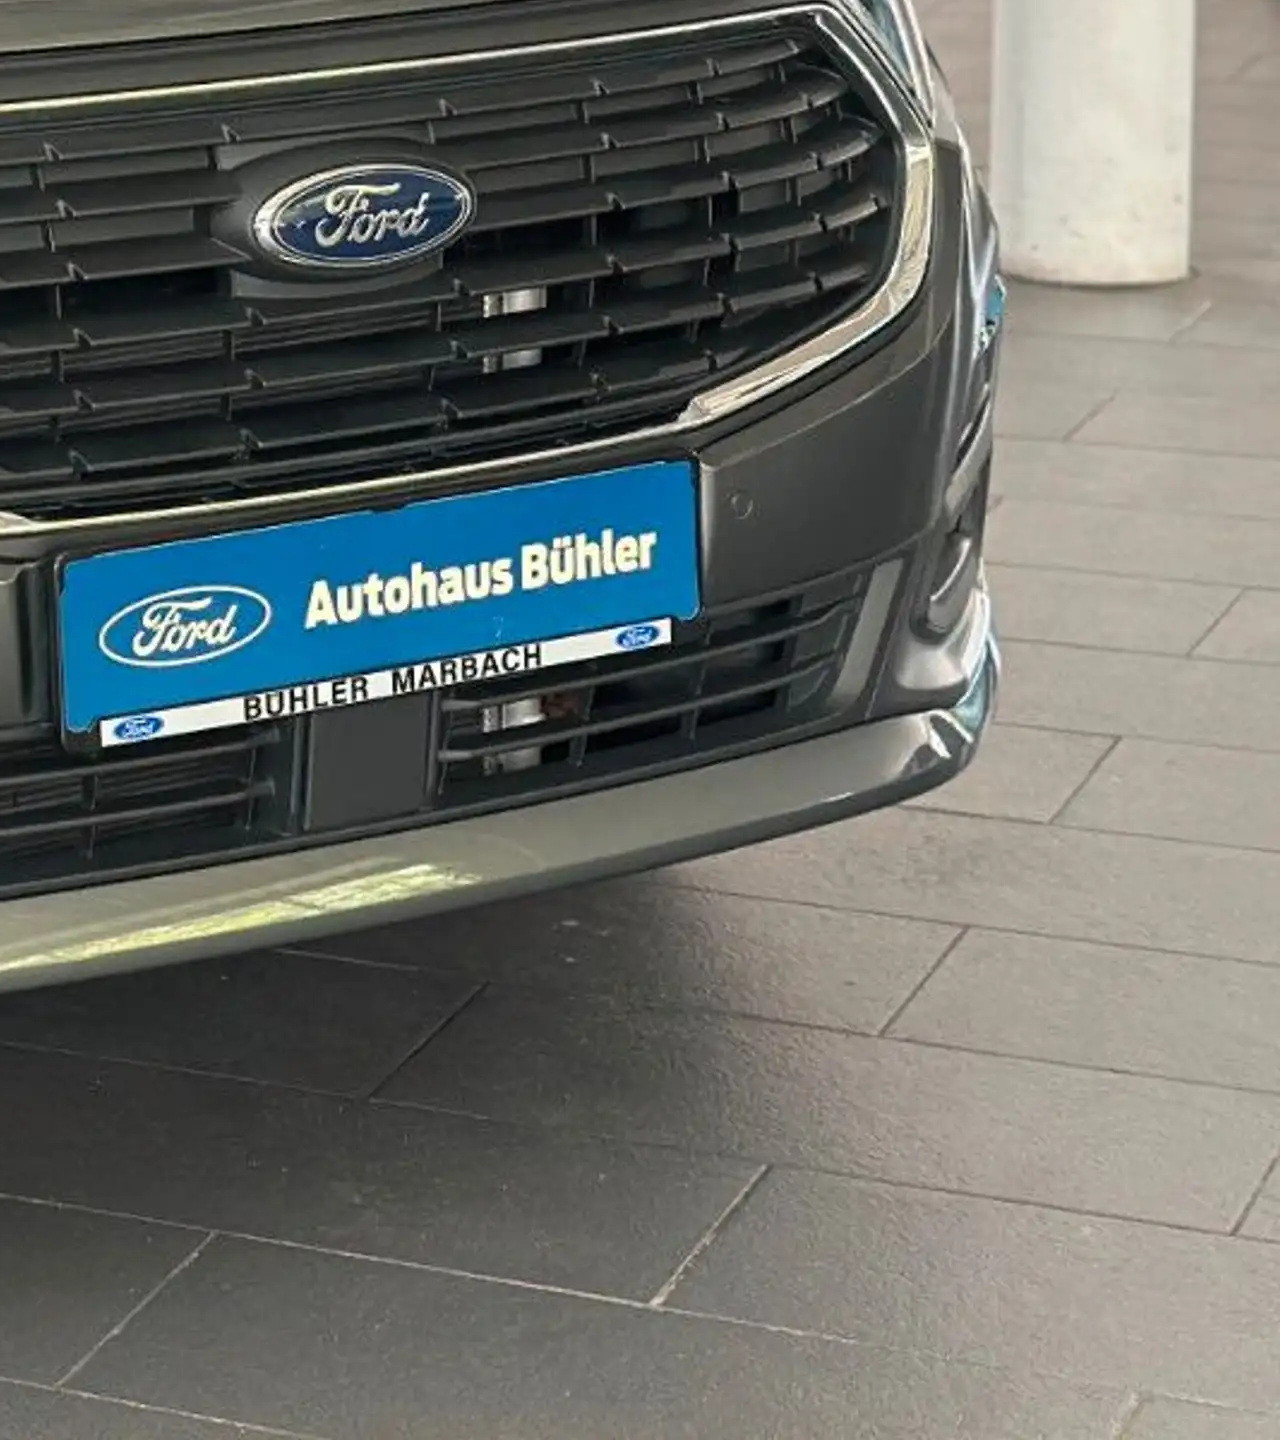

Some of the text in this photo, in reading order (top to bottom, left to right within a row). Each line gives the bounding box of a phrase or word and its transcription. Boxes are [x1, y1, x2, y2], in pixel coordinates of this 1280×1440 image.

[314, 181, 431, 248] Ford
[304, 527, 658, 630] Autohaus Bühler
[132, 596, 239, 657] Ford
[391, 642, 542, 694] MARBACH
